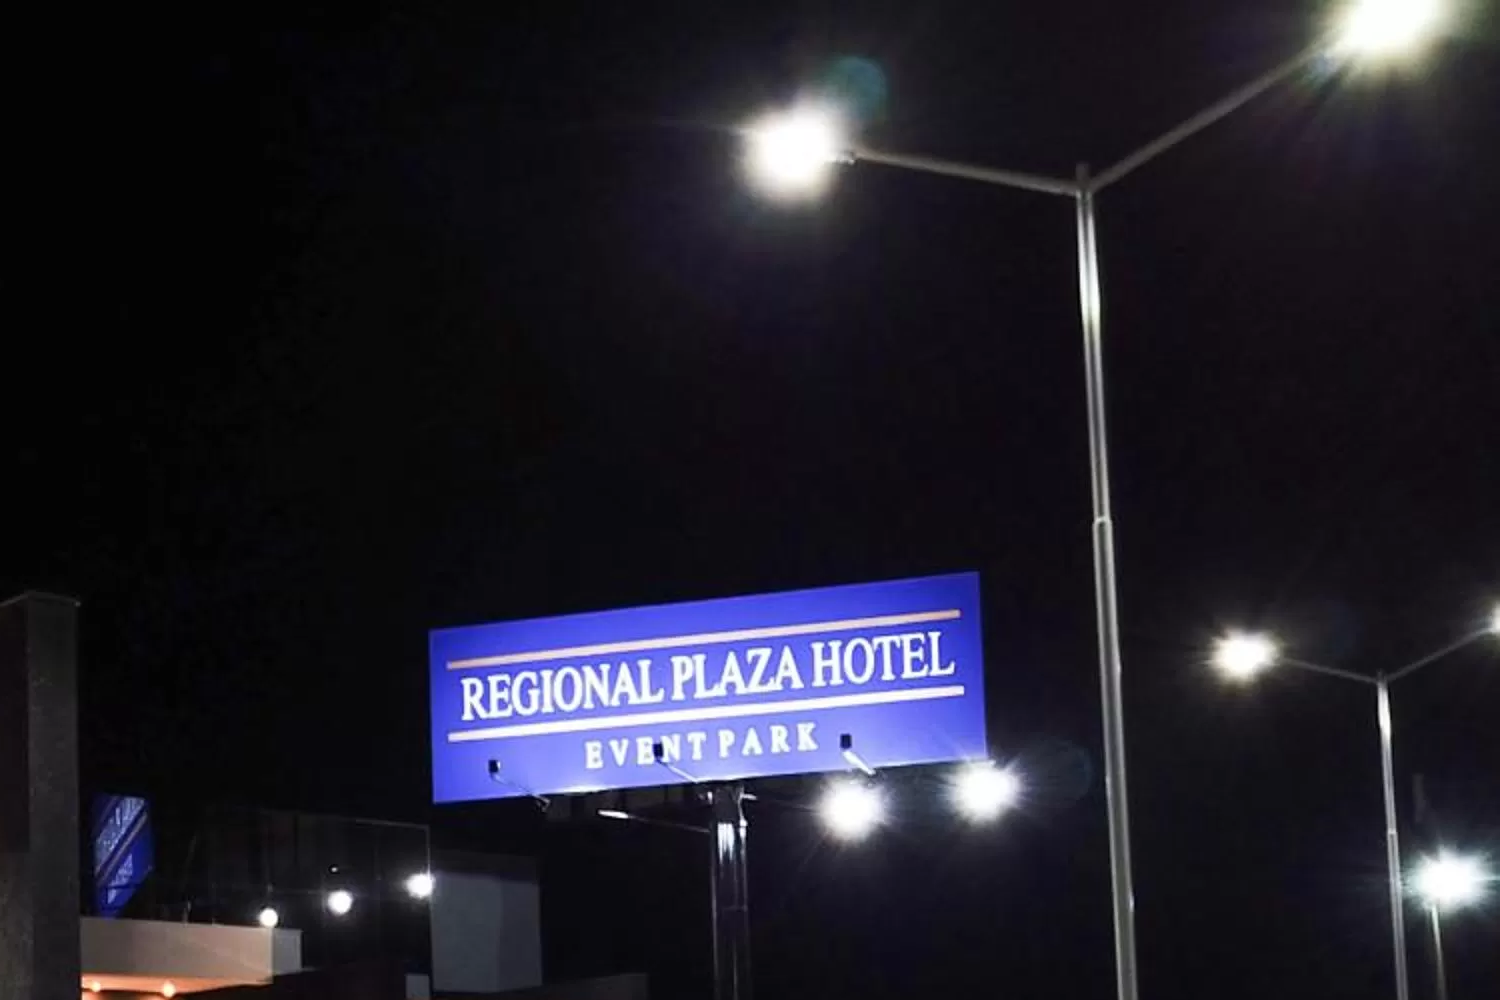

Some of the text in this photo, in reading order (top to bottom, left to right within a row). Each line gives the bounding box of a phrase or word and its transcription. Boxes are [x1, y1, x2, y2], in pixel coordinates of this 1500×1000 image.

[461, 631, 956, 721] REGIONAL PLAZA HOTEL
